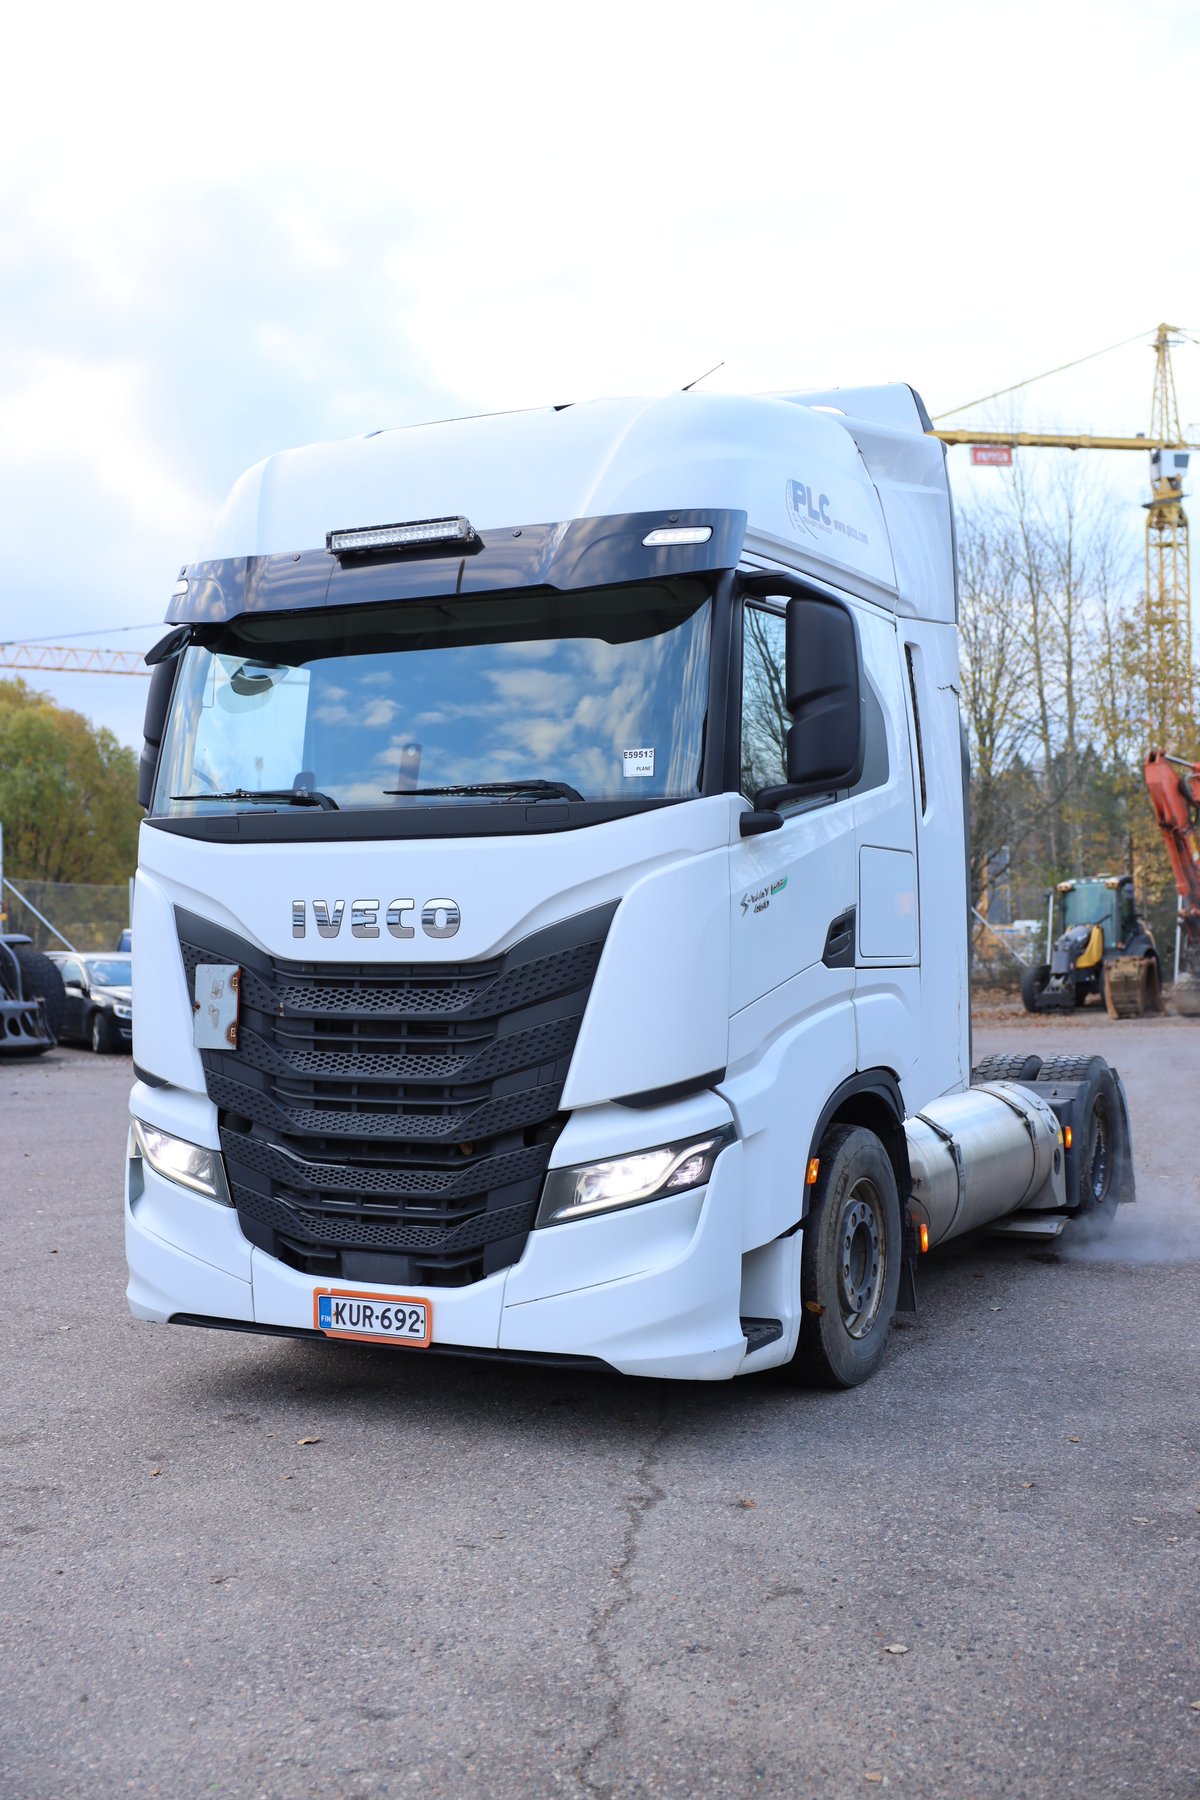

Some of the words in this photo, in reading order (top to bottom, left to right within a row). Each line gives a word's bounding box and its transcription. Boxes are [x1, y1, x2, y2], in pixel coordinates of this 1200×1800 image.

[791, 479, 831, 525] PLC
[292, 898, 461, 938] IVECO
[320, 1314, 331, 1322] FIN
[335, 1302, 420, 1333] KUR-692
